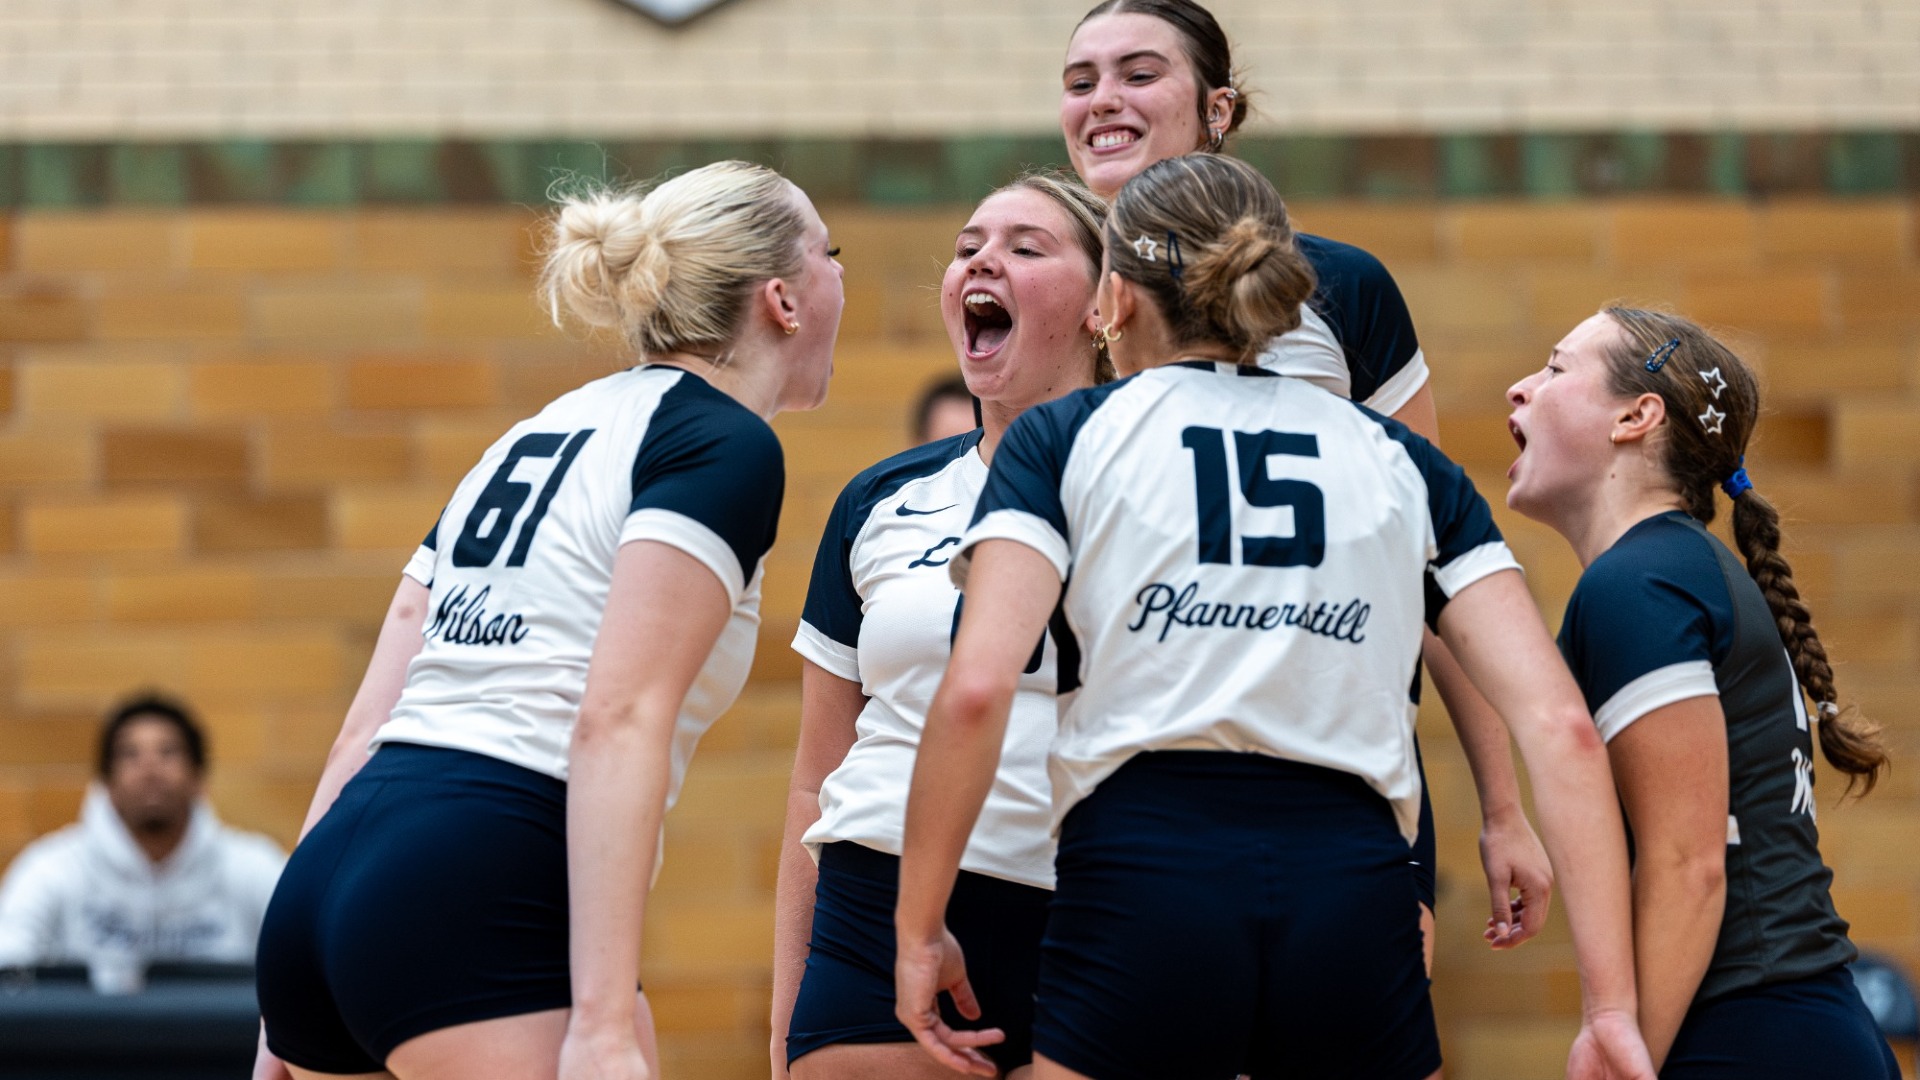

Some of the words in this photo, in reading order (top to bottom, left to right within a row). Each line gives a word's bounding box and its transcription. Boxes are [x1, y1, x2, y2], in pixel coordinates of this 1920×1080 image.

[452, 428, 597, 568] 61
[1181, 425, 1326, 569] 15
[1128, 581, 1371, 644] Pfannerstill
